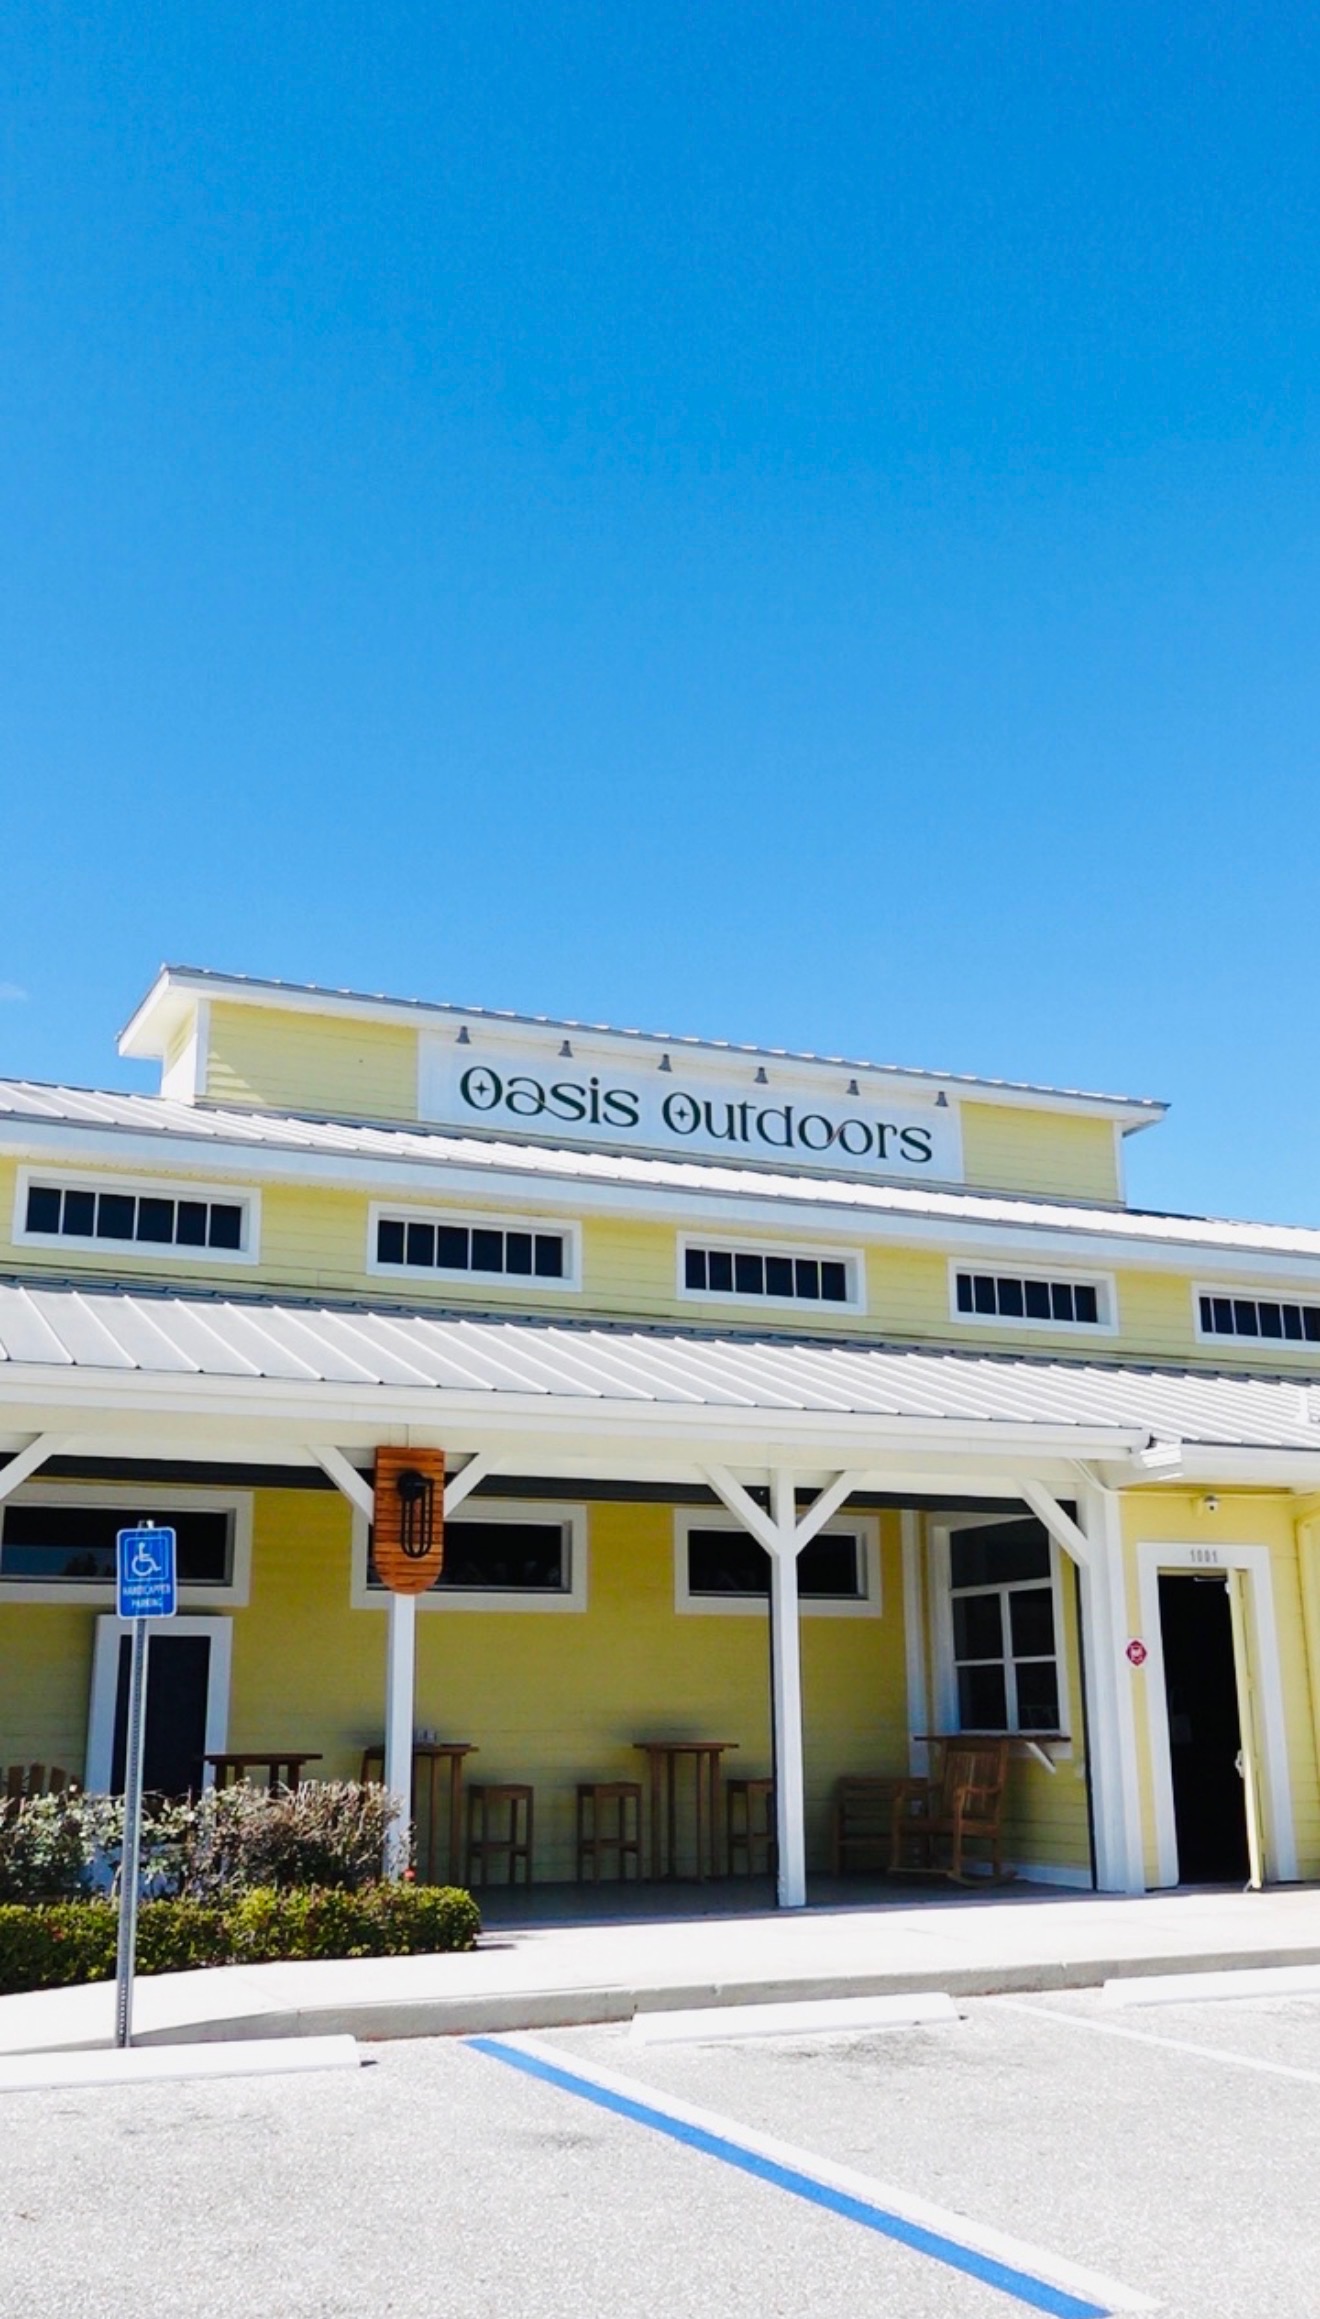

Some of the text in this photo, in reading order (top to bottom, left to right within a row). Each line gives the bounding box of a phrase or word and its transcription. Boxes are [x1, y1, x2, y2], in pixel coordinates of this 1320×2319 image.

[459, 1065, 933, 1164] Oasis Outdoors
[1190, 1549, 1218, 1563] 1001
